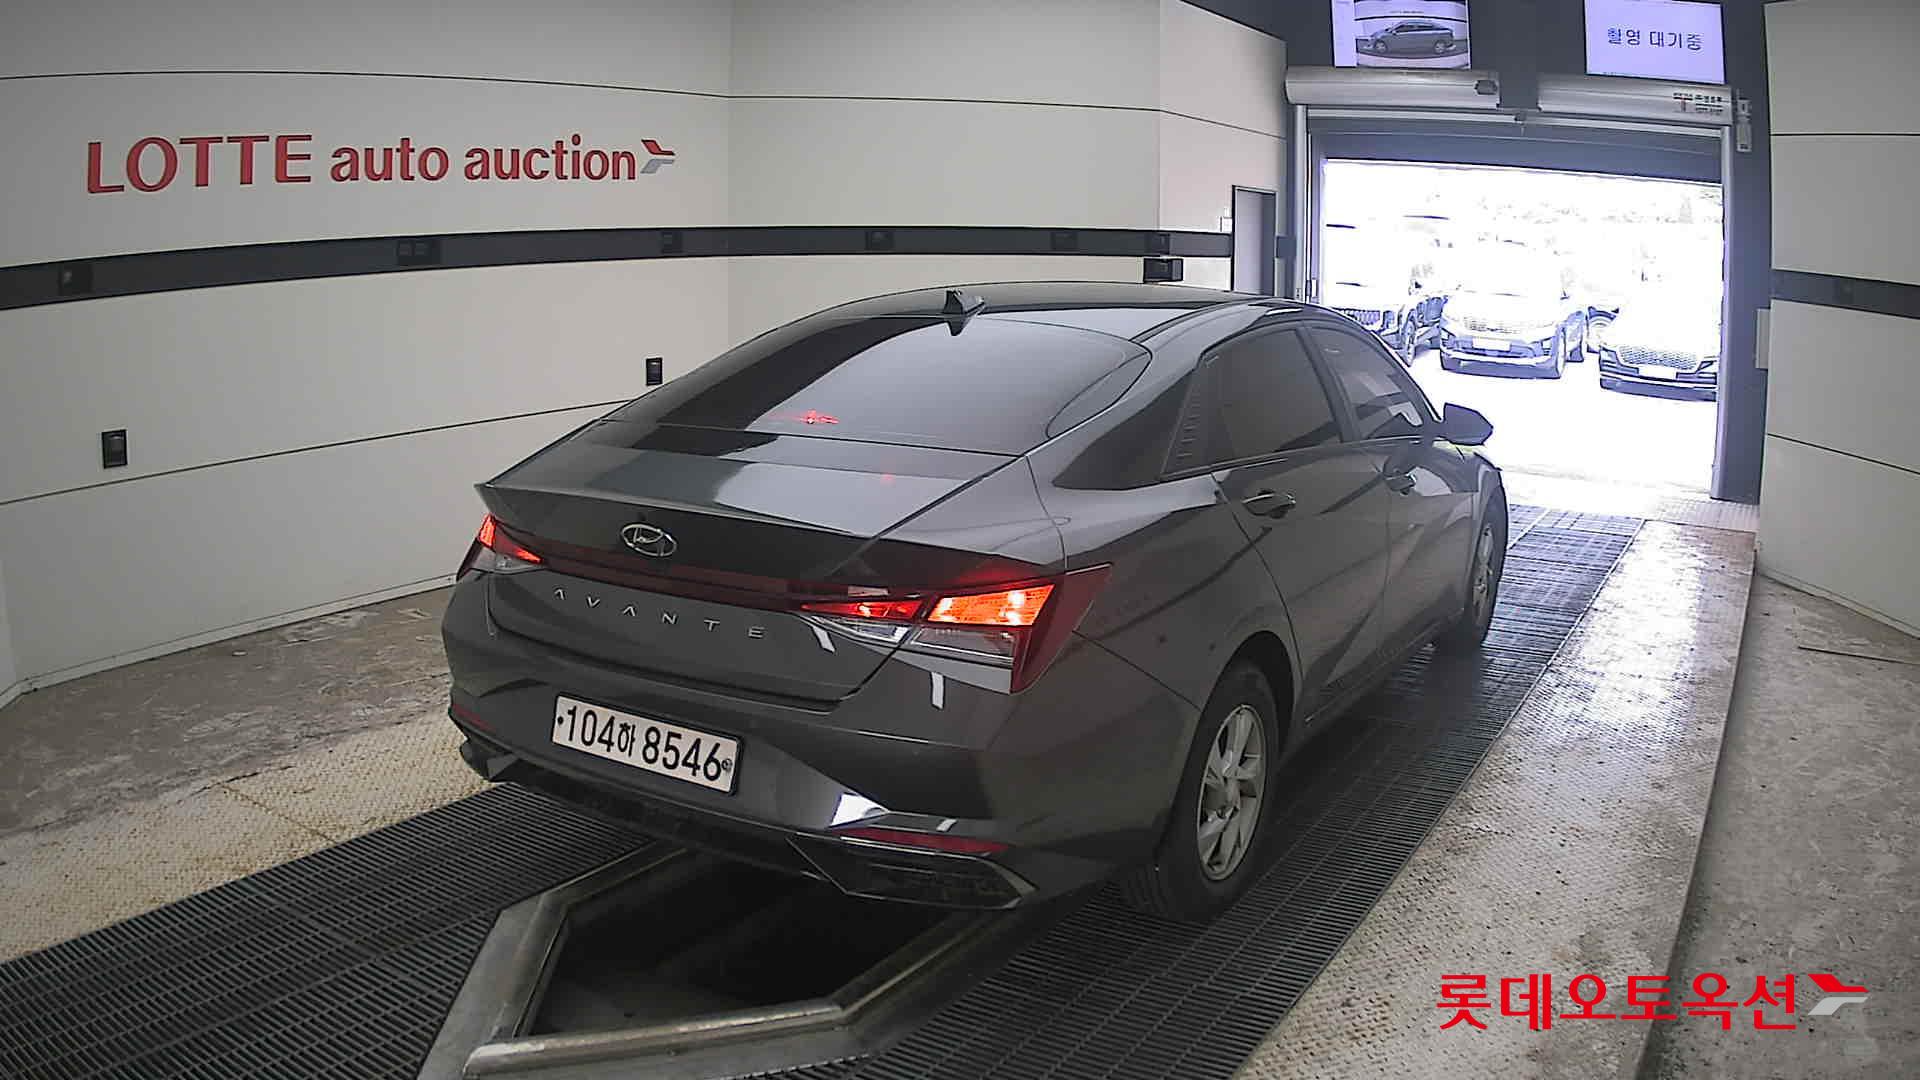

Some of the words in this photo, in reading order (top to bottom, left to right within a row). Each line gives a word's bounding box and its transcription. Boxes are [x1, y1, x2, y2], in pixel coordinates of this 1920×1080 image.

[1649, 31, 1702, 51] 대기중
[87, 134, 312, 194] LOTTE
[330, 137, 449, 182] auto
[463, 133, 637, 181] auction
[553, 587, 767, 640] AVANTE
[567, 705, 635, 758] 104하
[642, 726, 722, 781] 8546
